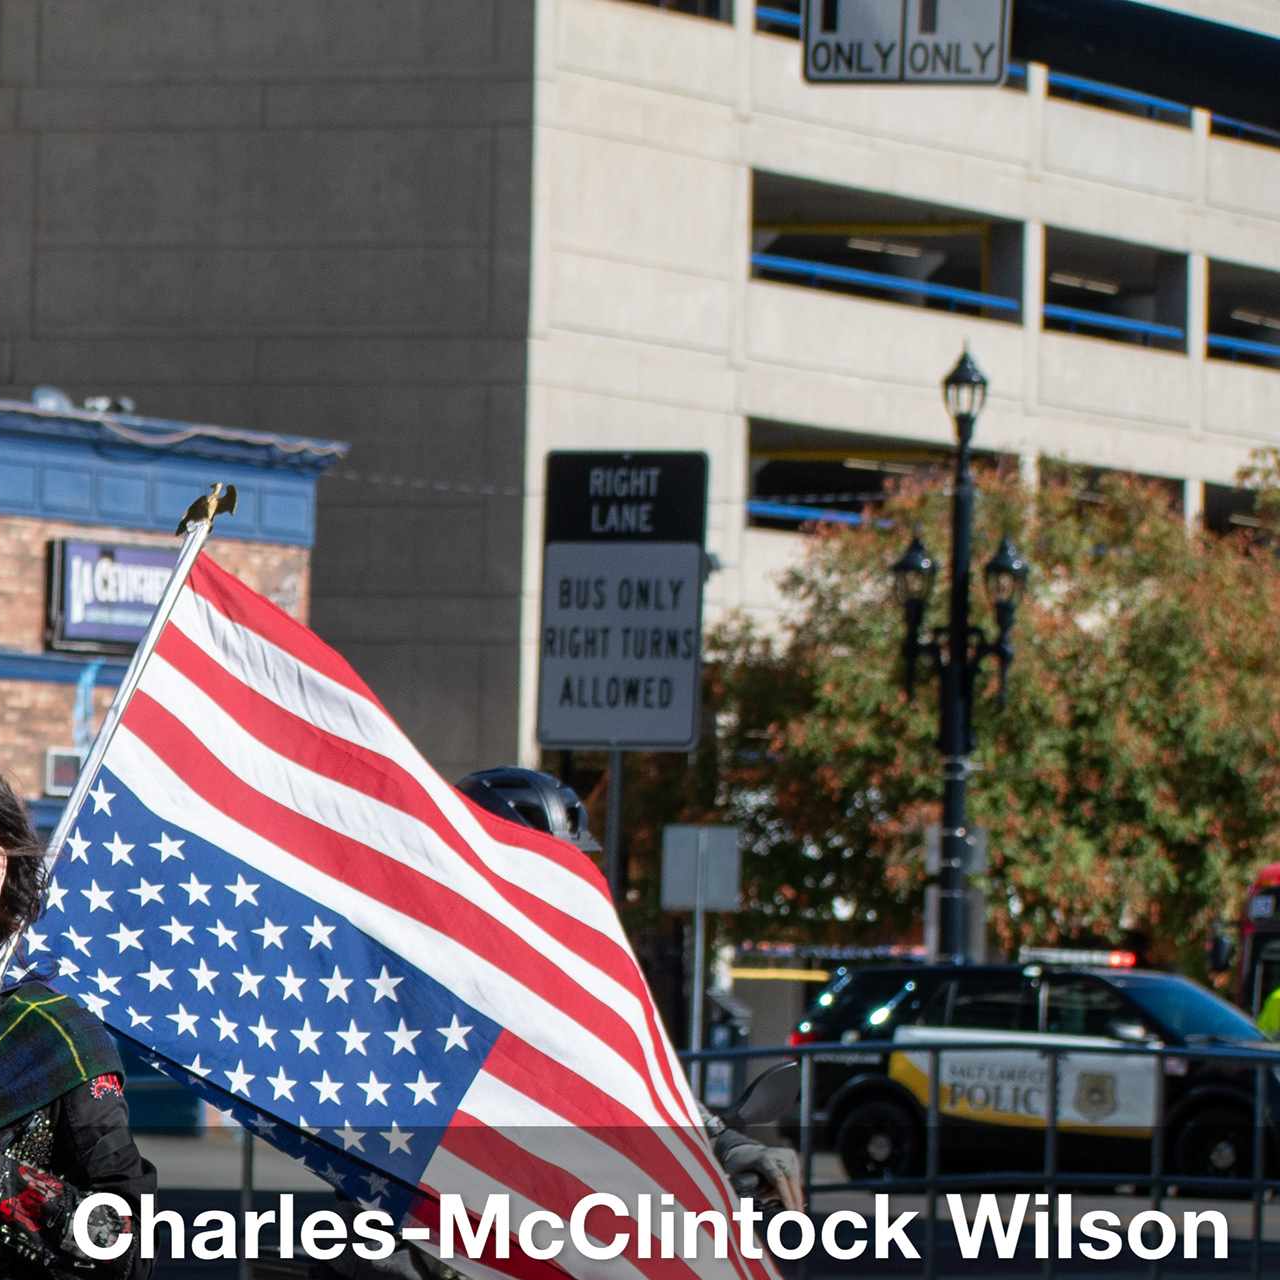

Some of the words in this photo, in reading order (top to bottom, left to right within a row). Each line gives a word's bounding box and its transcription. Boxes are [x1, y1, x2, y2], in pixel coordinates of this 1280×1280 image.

[812, 41, 896, 73] ONLY
[909, 42, 995, 75] ONLY
[590, 467, 660, 498] RIGHT
[591, 503, 653, 533] LANE
[559, 578, 605, 610] BUS
[617, 578, 684, 611] ONLY
[544, 626, 610, 659] RIGHT
[620, 627, 694, 660] TURNS
[559, 675, 674, 709] ALLOWED
[950, 1082, 1047, 1116] POLIC
